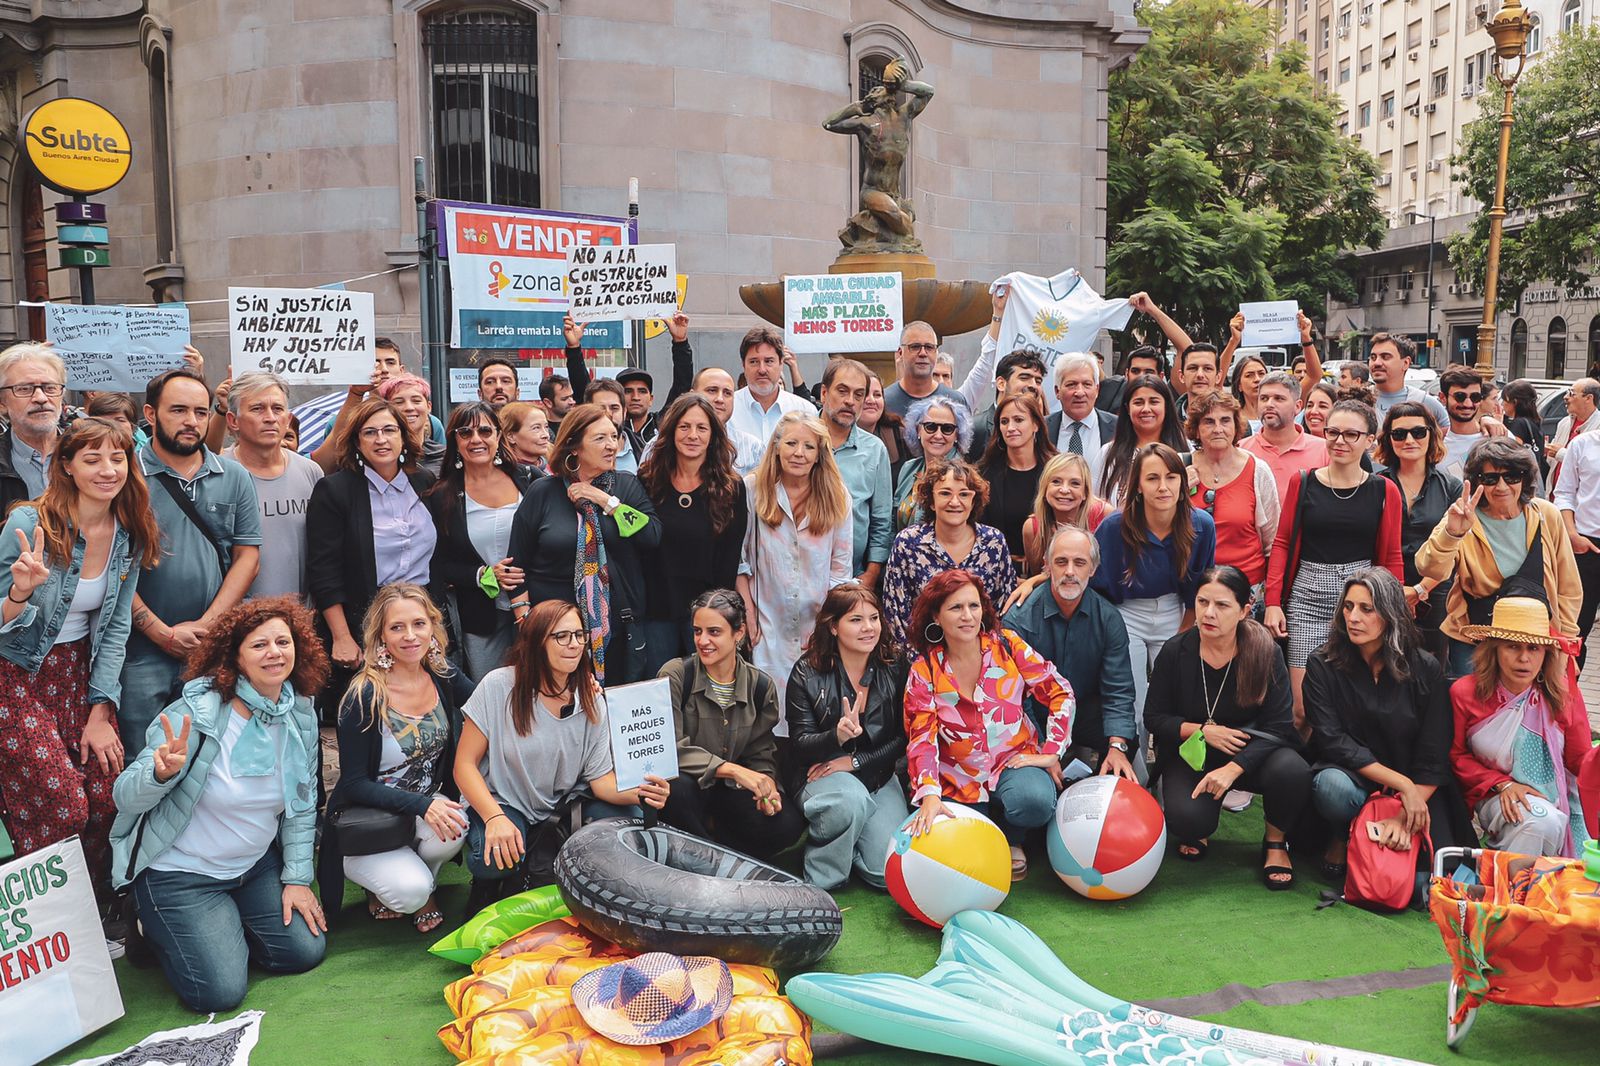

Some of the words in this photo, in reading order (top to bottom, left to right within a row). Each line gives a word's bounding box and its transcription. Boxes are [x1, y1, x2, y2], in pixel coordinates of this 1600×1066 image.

[41, 126, 117, 154] Subte
[42, 152, 71, 160] Buenos
[93, 155, 120, 163] Ciudad
[82, 205, 91, 218] E
[82, 227, 95, 240] A
[492, 222, 592, 253] VENDE
[84, 250, 96, 263] D
[573, 247, 596, 264] NO
[603, 250, 612, 264] A
[617, 248, 636, 264] LA
[573, 284, 593, 296] DE
[601, 280, 653, 294] TORRES
[788, 278, 814, 292] POR
[817, 278, 844, 291] UNA
[847, 276, 896, 290] CIUDAD
[574, 297, 591, 308] EN
[595, 295, 613, 307] LA
[617, 291, 677, 307] COSTANERA
[811, 290, 880, 306] AMIGABLE:
[1523, 288, 1557, 303] HOTEL
[236, 295, 268, 313] SIN
[276, 295, 352, 314] JUSTICIA
[802, 304, 828, 320] MÁS
[833, 304, 890, 319] PLAZAS,
[237, 313, 323, 334] AMBIENTAL
[336, 318, 359, 334] NO
[477, 324, 515, 336] Larreta
[517, 325, 551, 336] remata
[553, 325, 562, 336] la
[583, 327, 608, 337] anera
[793, 320, 837, 335] MENOS
[841, 319, 894, 333] TORRES
[242, 336, 278, 353] HAY
[283, 333, 366, 355] JUSTICIA
[258, 351, 331, 375] SOCIAL
[262, 498, 309, 517] LUM
[631, 705, 652, 718] MÁS
[620, 716, 665, 734] PARQUES
[628, 731, 661, 747] MENOS
[627, 744, 665, 761] TORRES
[0, 931, 71, 992] ENTO
